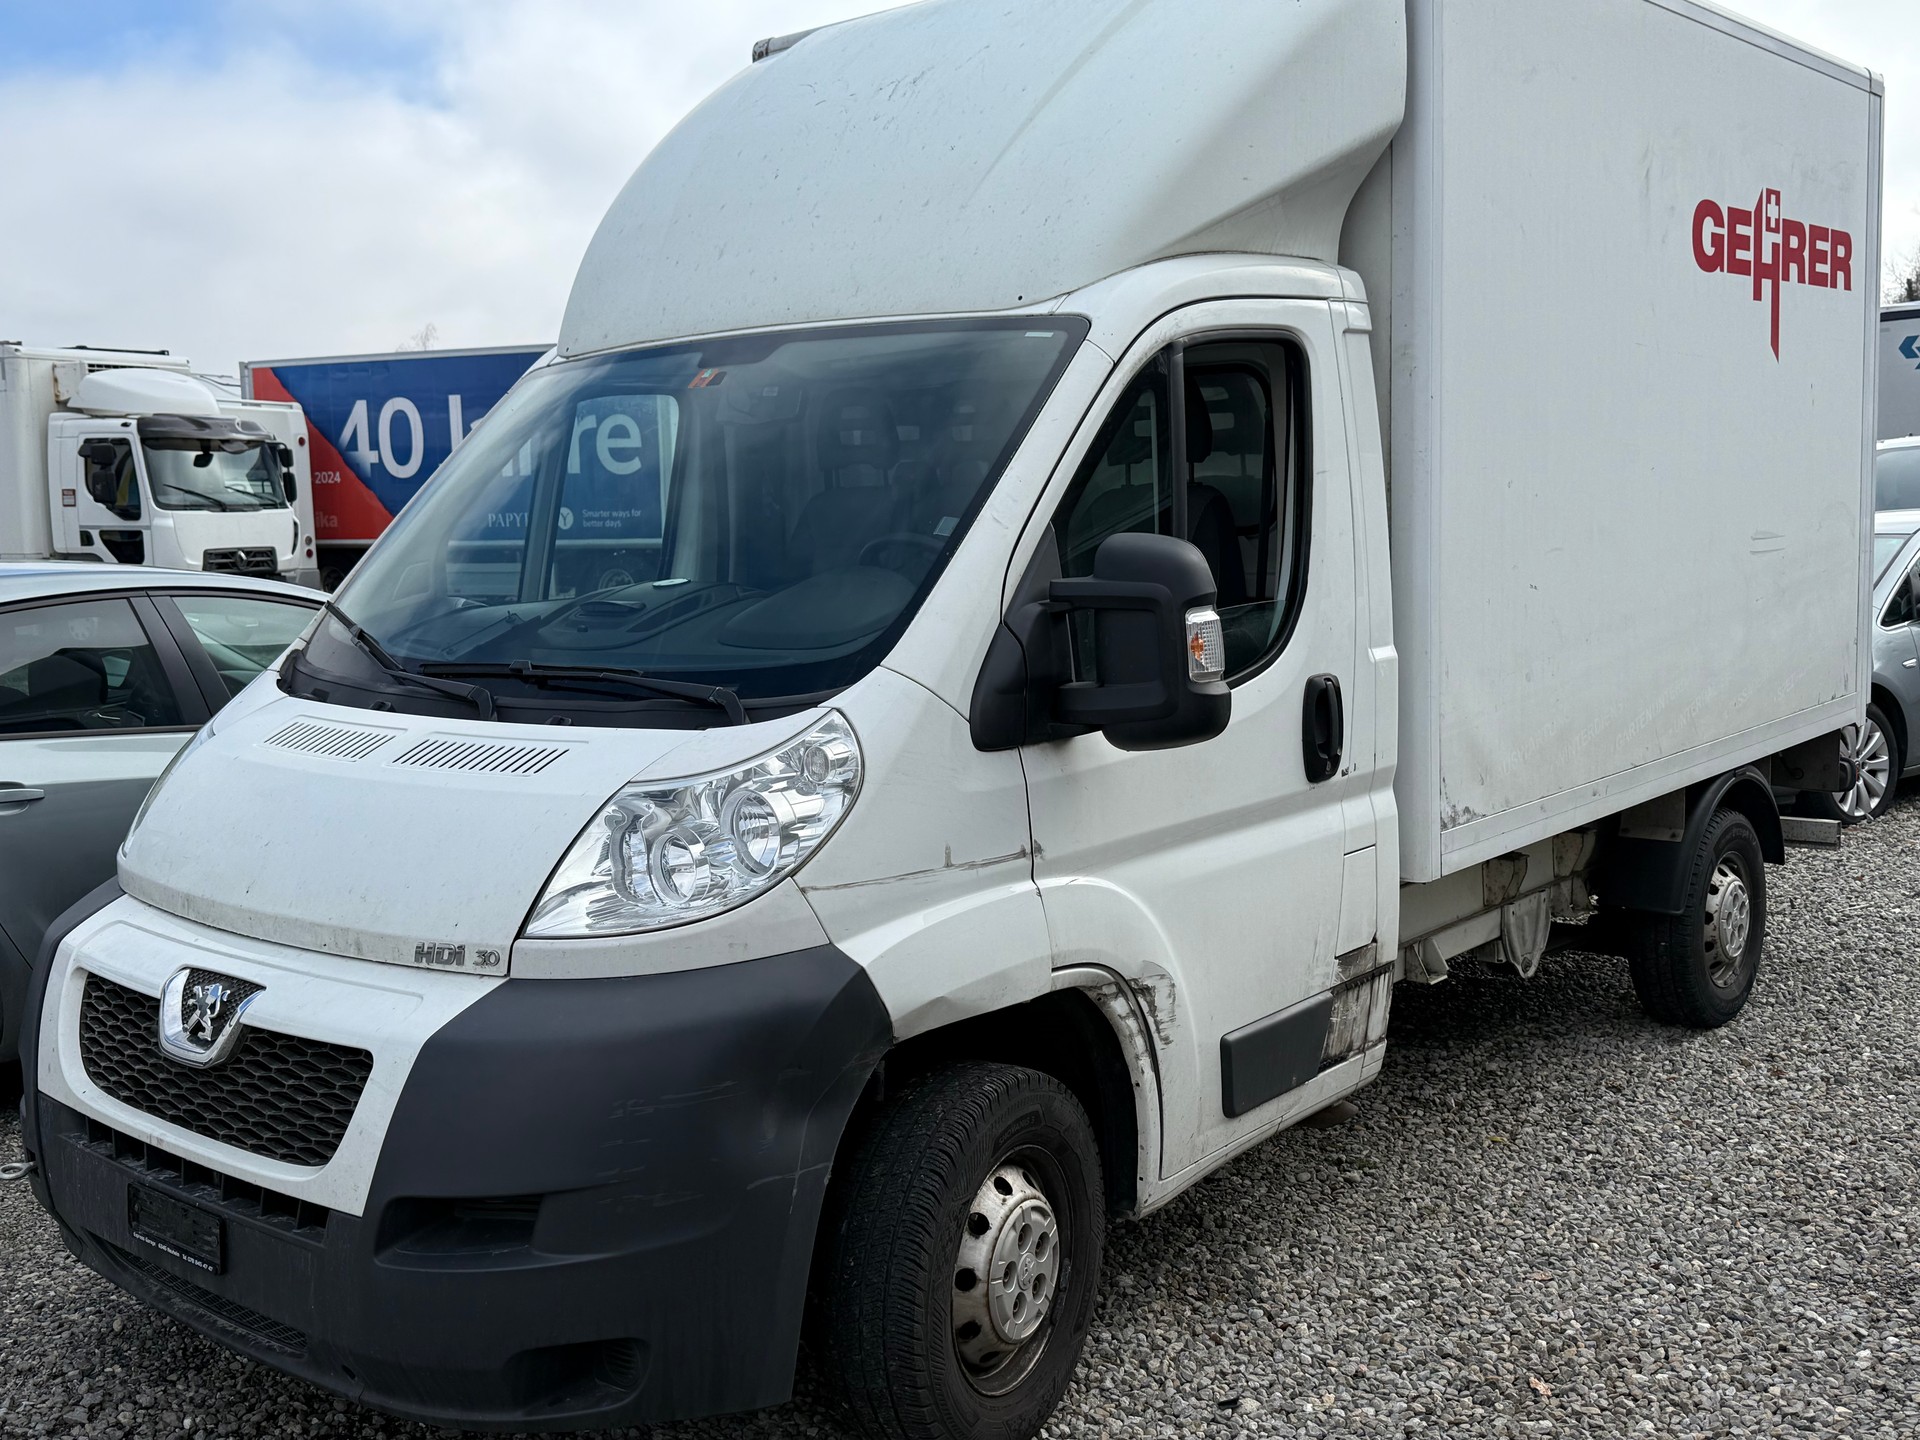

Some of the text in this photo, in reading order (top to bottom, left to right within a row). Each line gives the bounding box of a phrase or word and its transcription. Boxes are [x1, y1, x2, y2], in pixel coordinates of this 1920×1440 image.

[1692, 187, 1853, 363] GEHRER
[338, 396, 424, 479] 40
[315, 471, 341, 484] 2024
[315, 511, 338, 528] ika
[582, 508, 642, 519] Smarter ways for
[583, 519, 621, 528] better days
[414, 941, 501, 968] HDi 30
